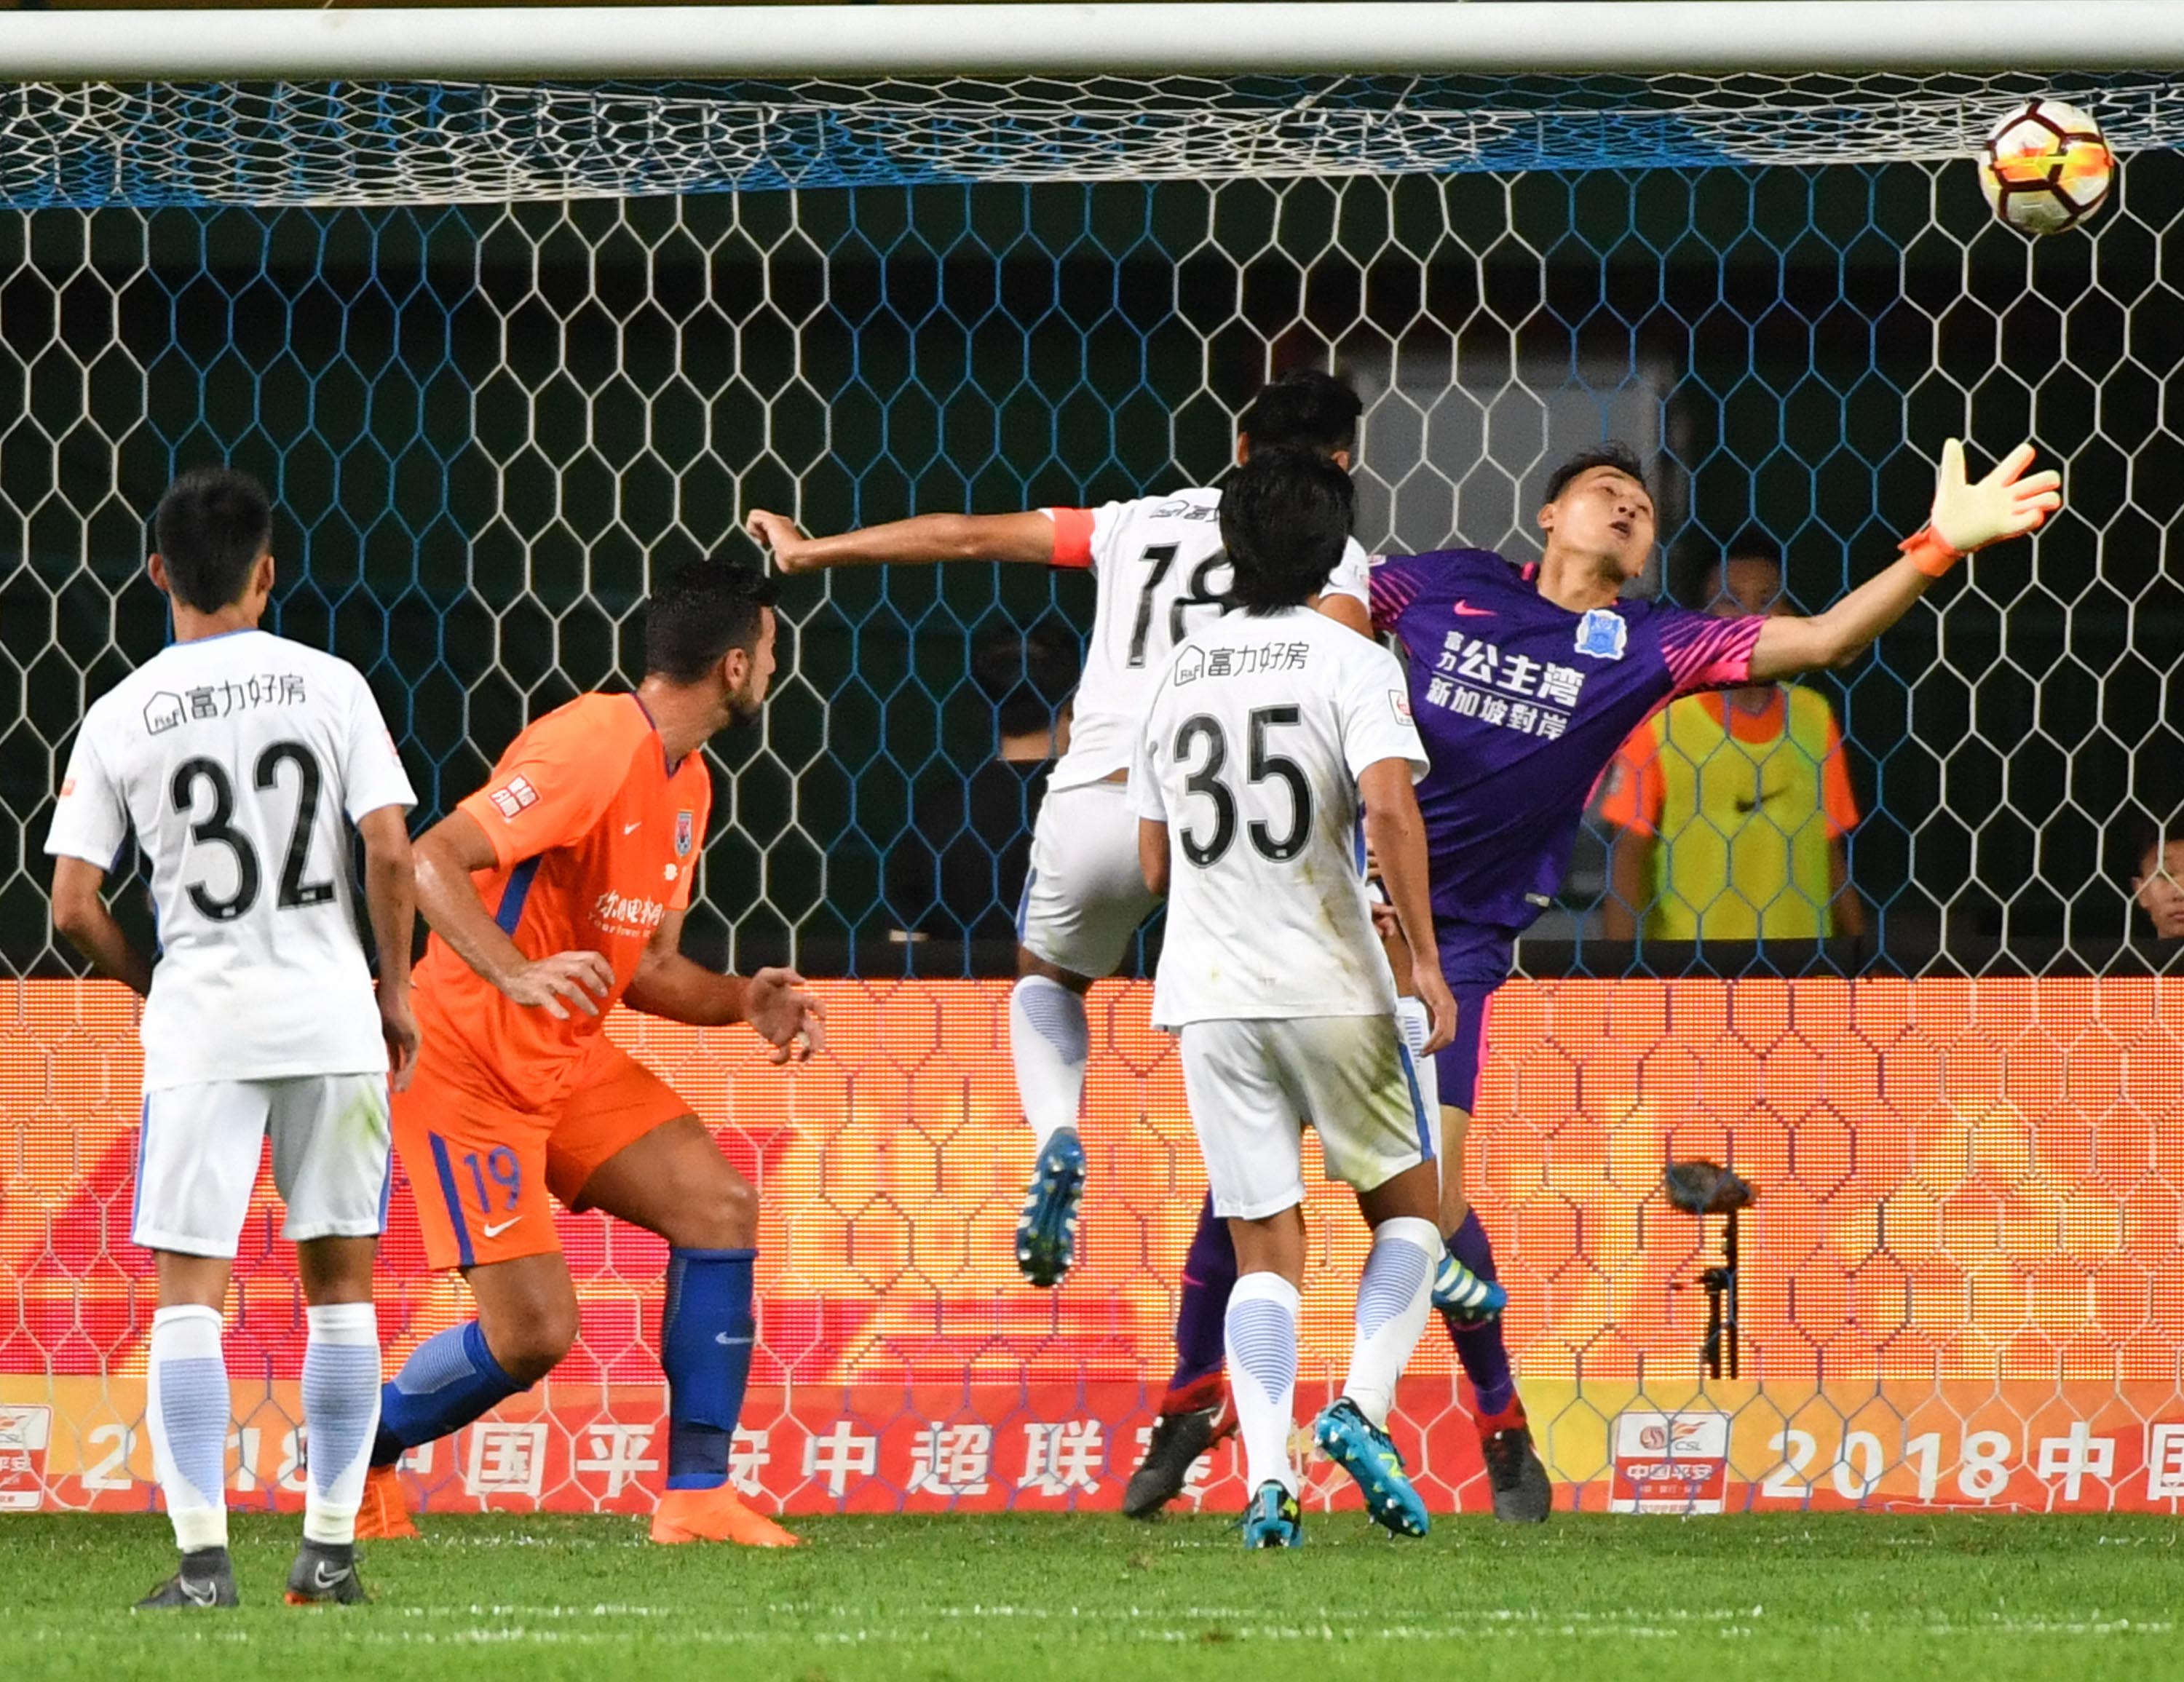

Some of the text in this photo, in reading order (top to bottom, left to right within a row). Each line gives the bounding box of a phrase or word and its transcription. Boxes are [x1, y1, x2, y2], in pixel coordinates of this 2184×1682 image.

[1208, 641, 1309, 677] 富力好房
[1457, 639, 1586, 708] 公主湾
[185, 673, 306, 719] 富力好房
[1425, 677, 1568, 741] 新加坡對岸
[1174, 703, 1314, 868] 35
[170, 739, 336, 923] 32
[464, 1145, 521, 1214] 19
[1626, 1464, 1713, 1480] 中国平安
